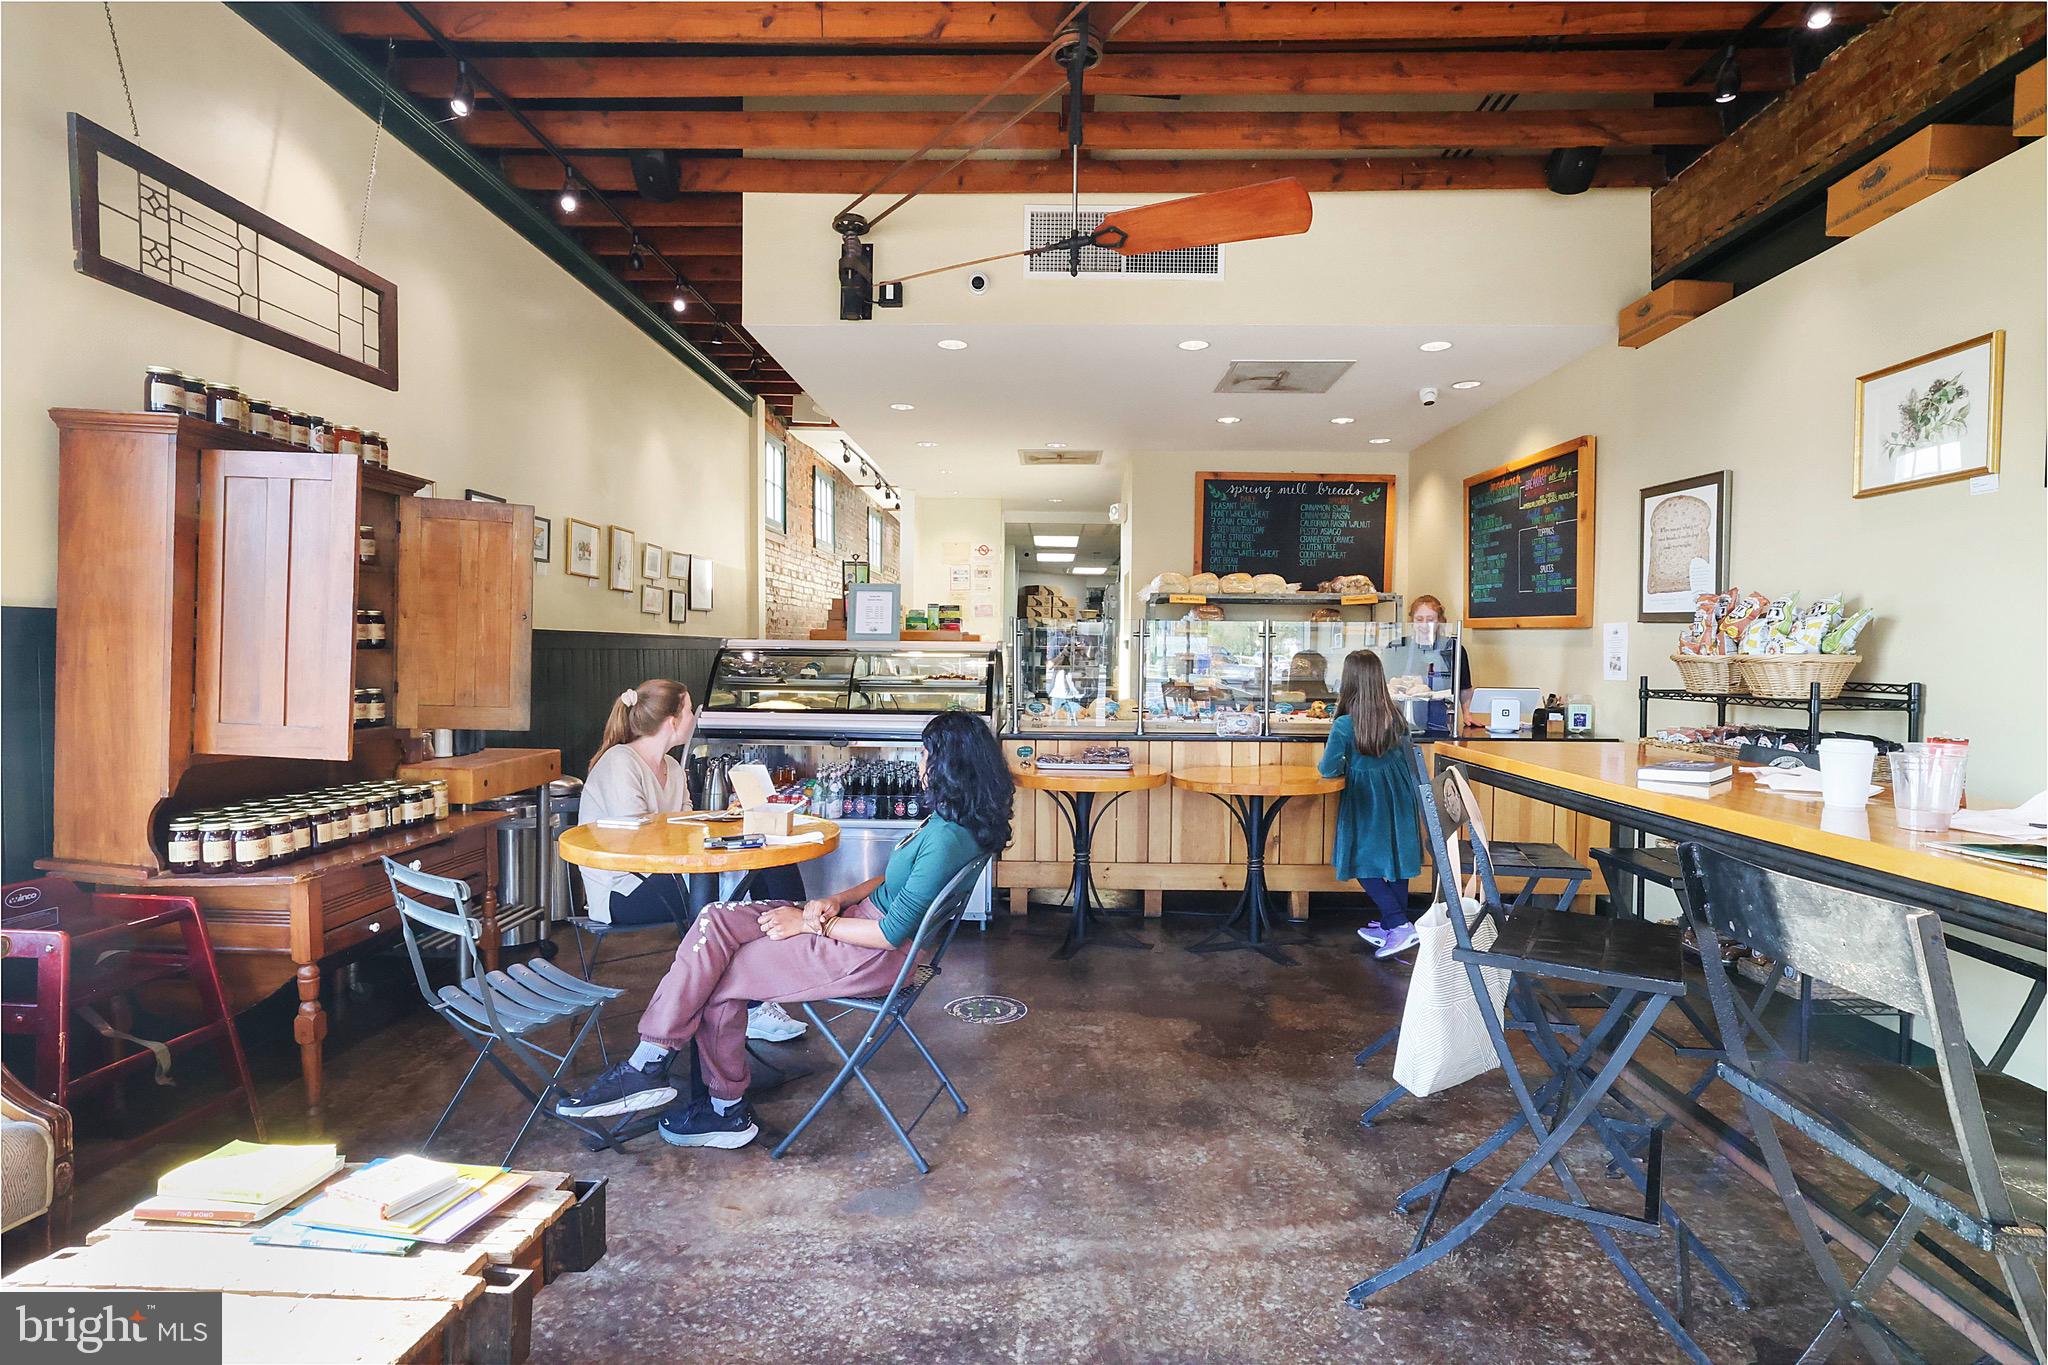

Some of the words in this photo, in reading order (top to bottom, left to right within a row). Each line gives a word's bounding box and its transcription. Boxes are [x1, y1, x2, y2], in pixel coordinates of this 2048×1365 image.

[1226, 484, 1273, 500] spring
[1278, 483, 1308, 495] mill
[1316, 482, 1364, 496] breads
[1300, 504, 1331, 512] CINNAMON
[1331, 512, 1351, 520] RAISIN
[1322, 544, 1337, 552] FREE
